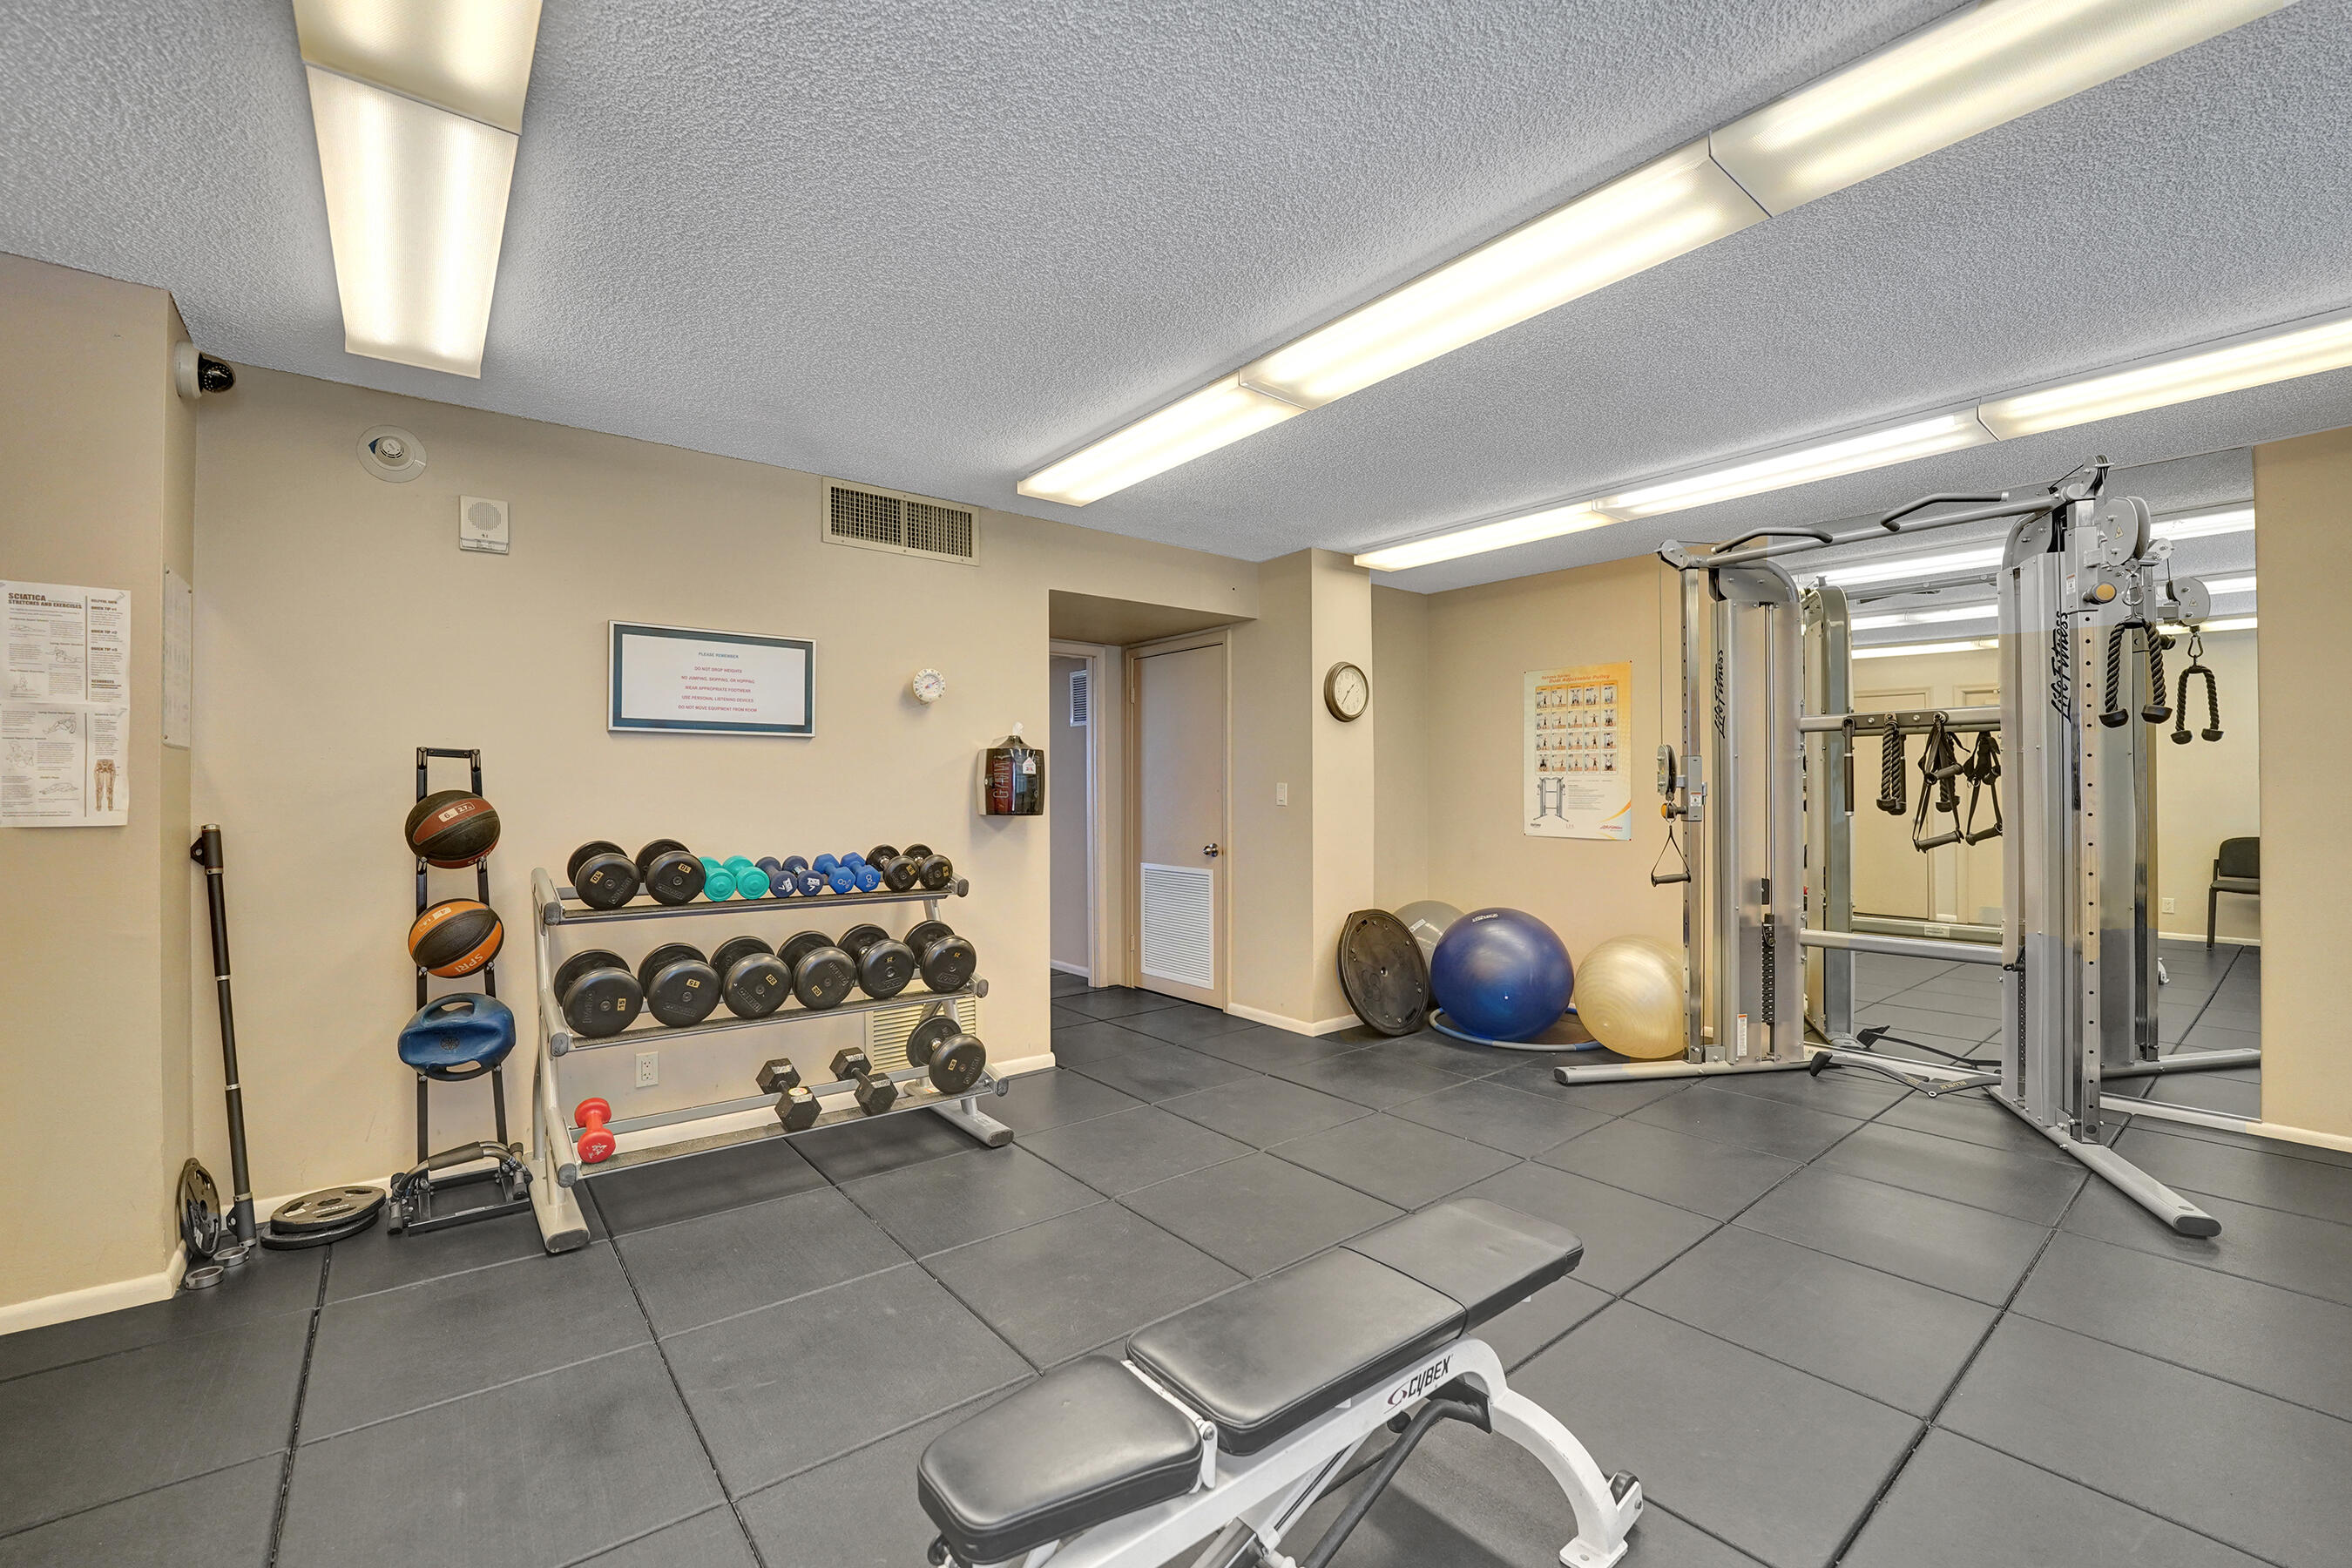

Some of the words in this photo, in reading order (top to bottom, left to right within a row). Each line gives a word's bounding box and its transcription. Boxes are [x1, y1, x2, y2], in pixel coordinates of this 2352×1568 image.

[8, 592, 46, 601] SCIATICA
[2051, 611, 2071, 681] Fitness
[865, 874, 873, 883] 8
[454, 953, 483, 973] SPRI
[1408, 1355, 1451, 1397] CYBEX
